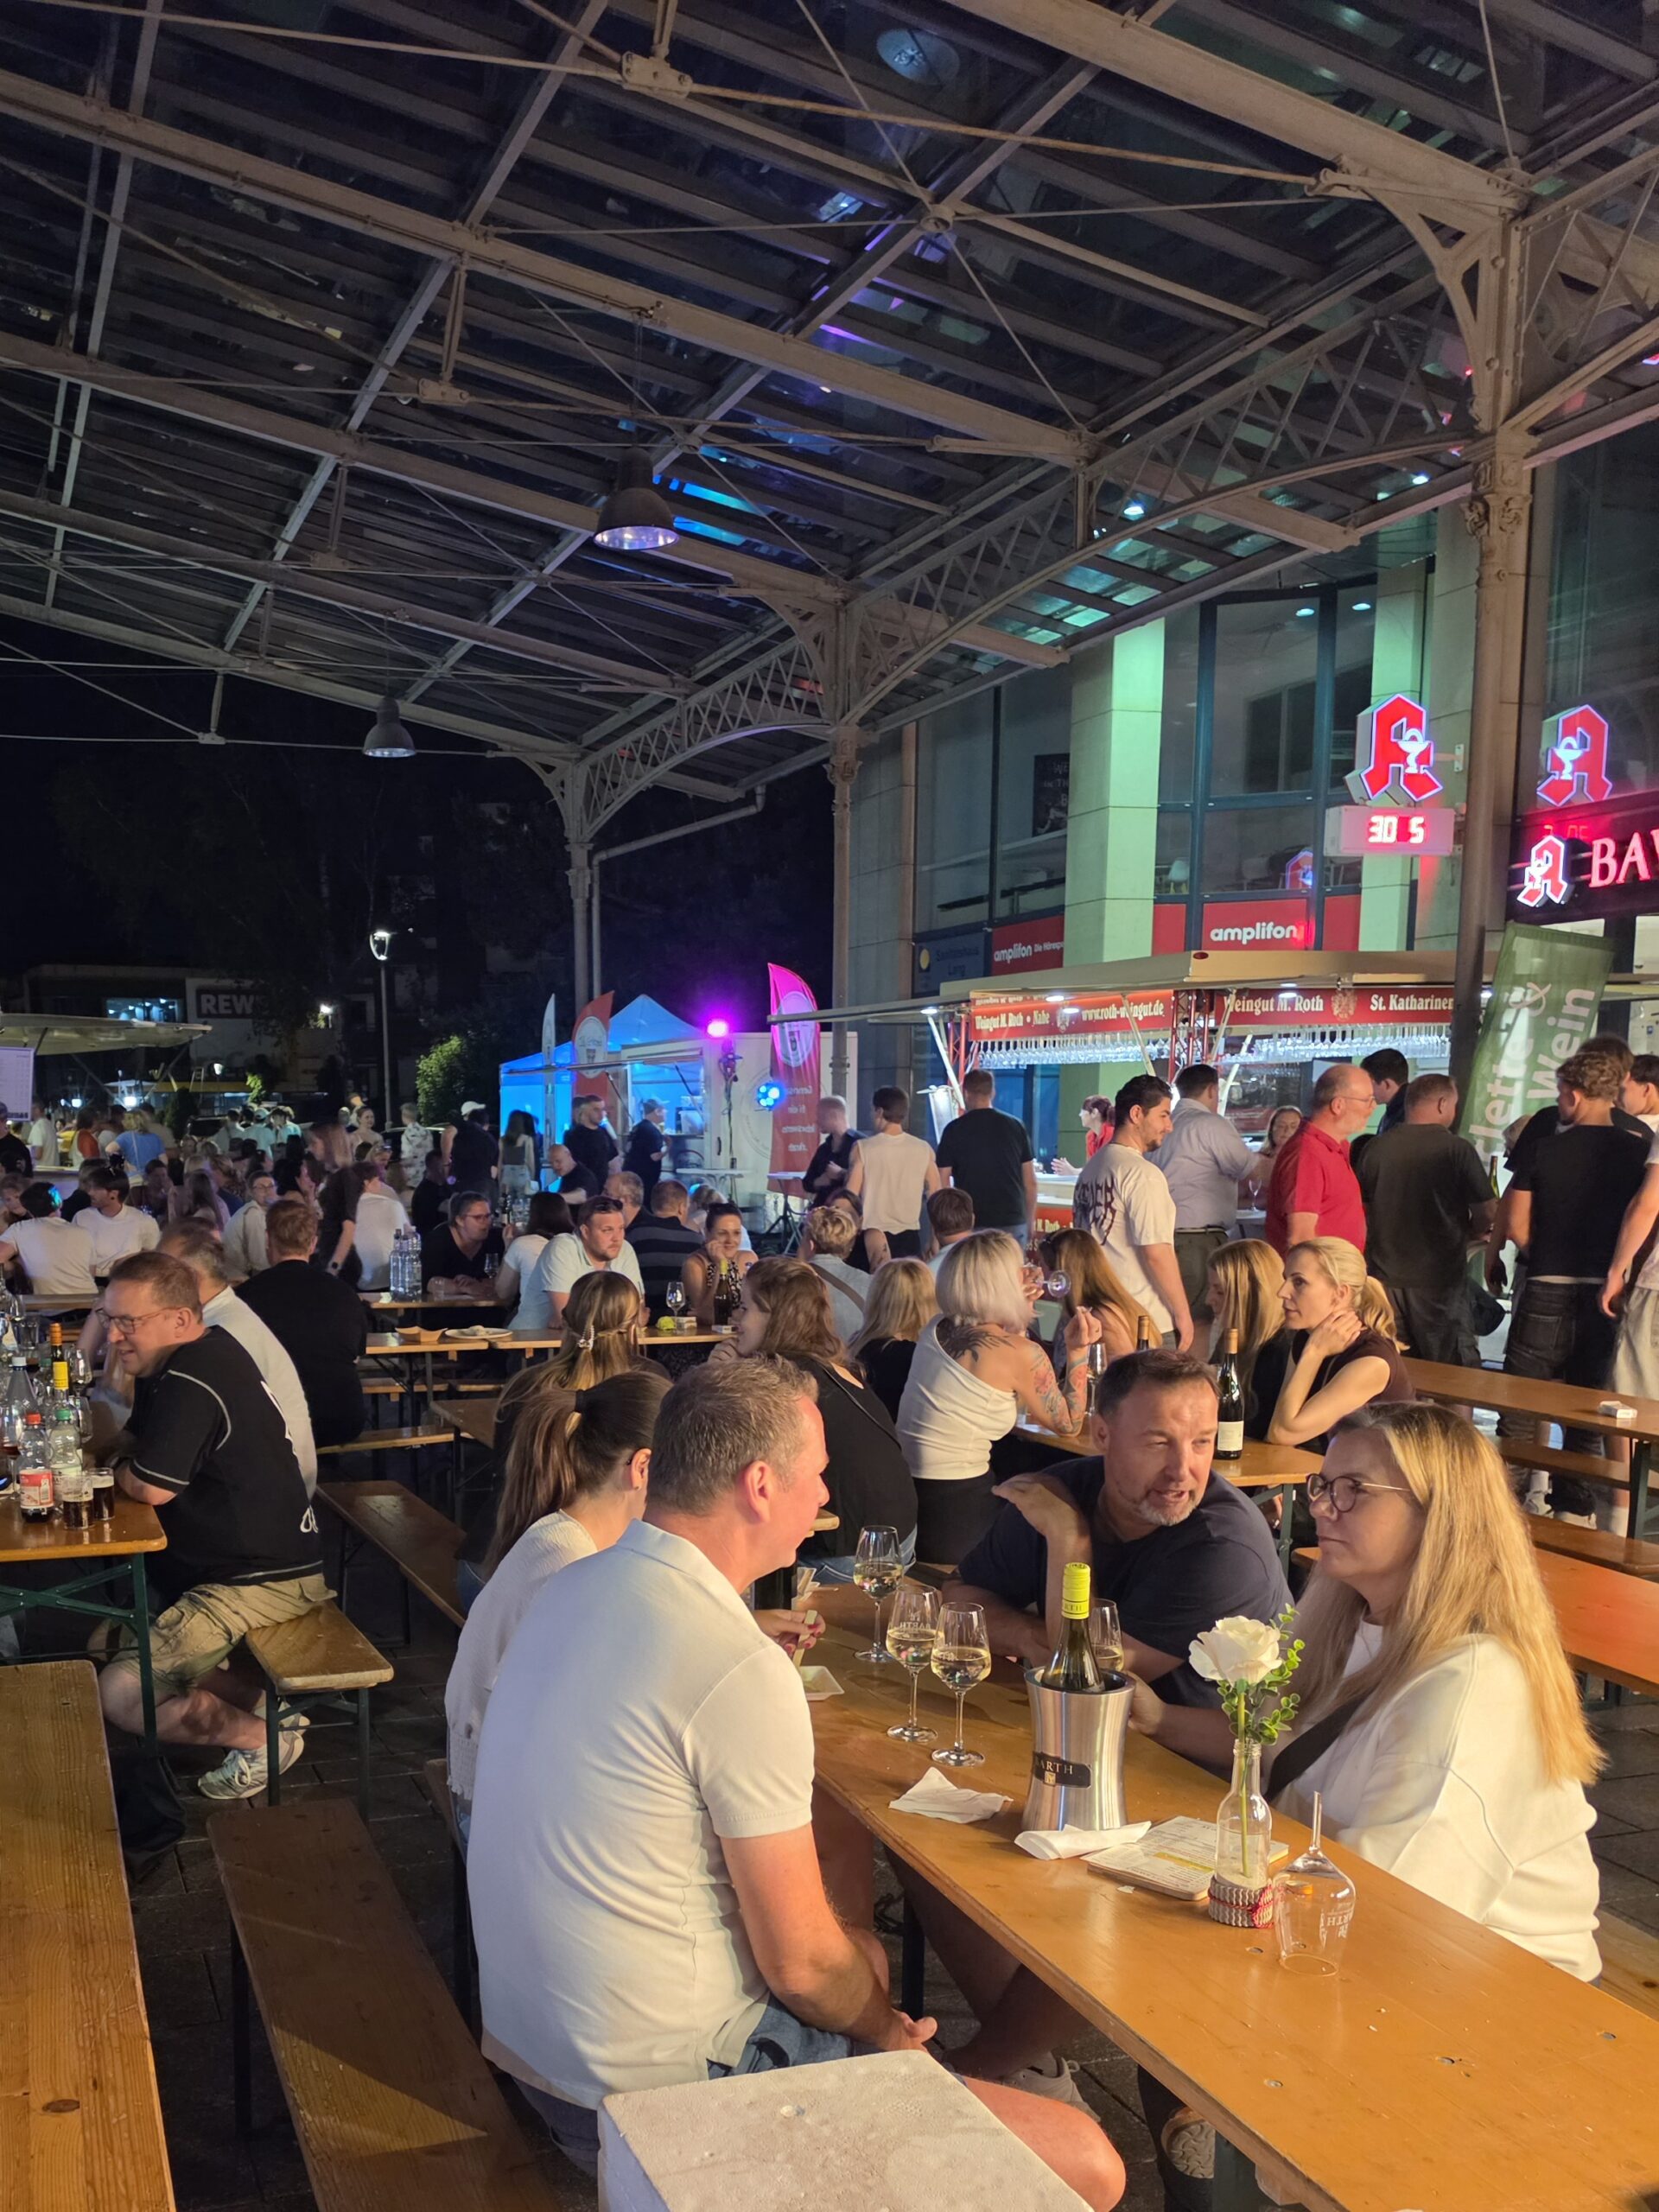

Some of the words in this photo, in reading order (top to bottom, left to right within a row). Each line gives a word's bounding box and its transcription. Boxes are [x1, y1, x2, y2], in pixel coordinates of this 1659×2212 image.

[1210, 921, 1299, 945] amplifon
[994, 942, 1033, 963] amplifon
[200, 994, 255, 1014] REW
[1295, 995, 1324, 1013] Roth
[1370, 995, 1387, 1011] St.
[976, 1014, 1000, 1033] Weingut
[1008, 1012, 1024, 1027] Roth
[1081, 999, 1165, 1021] www.roth-wingut.de
